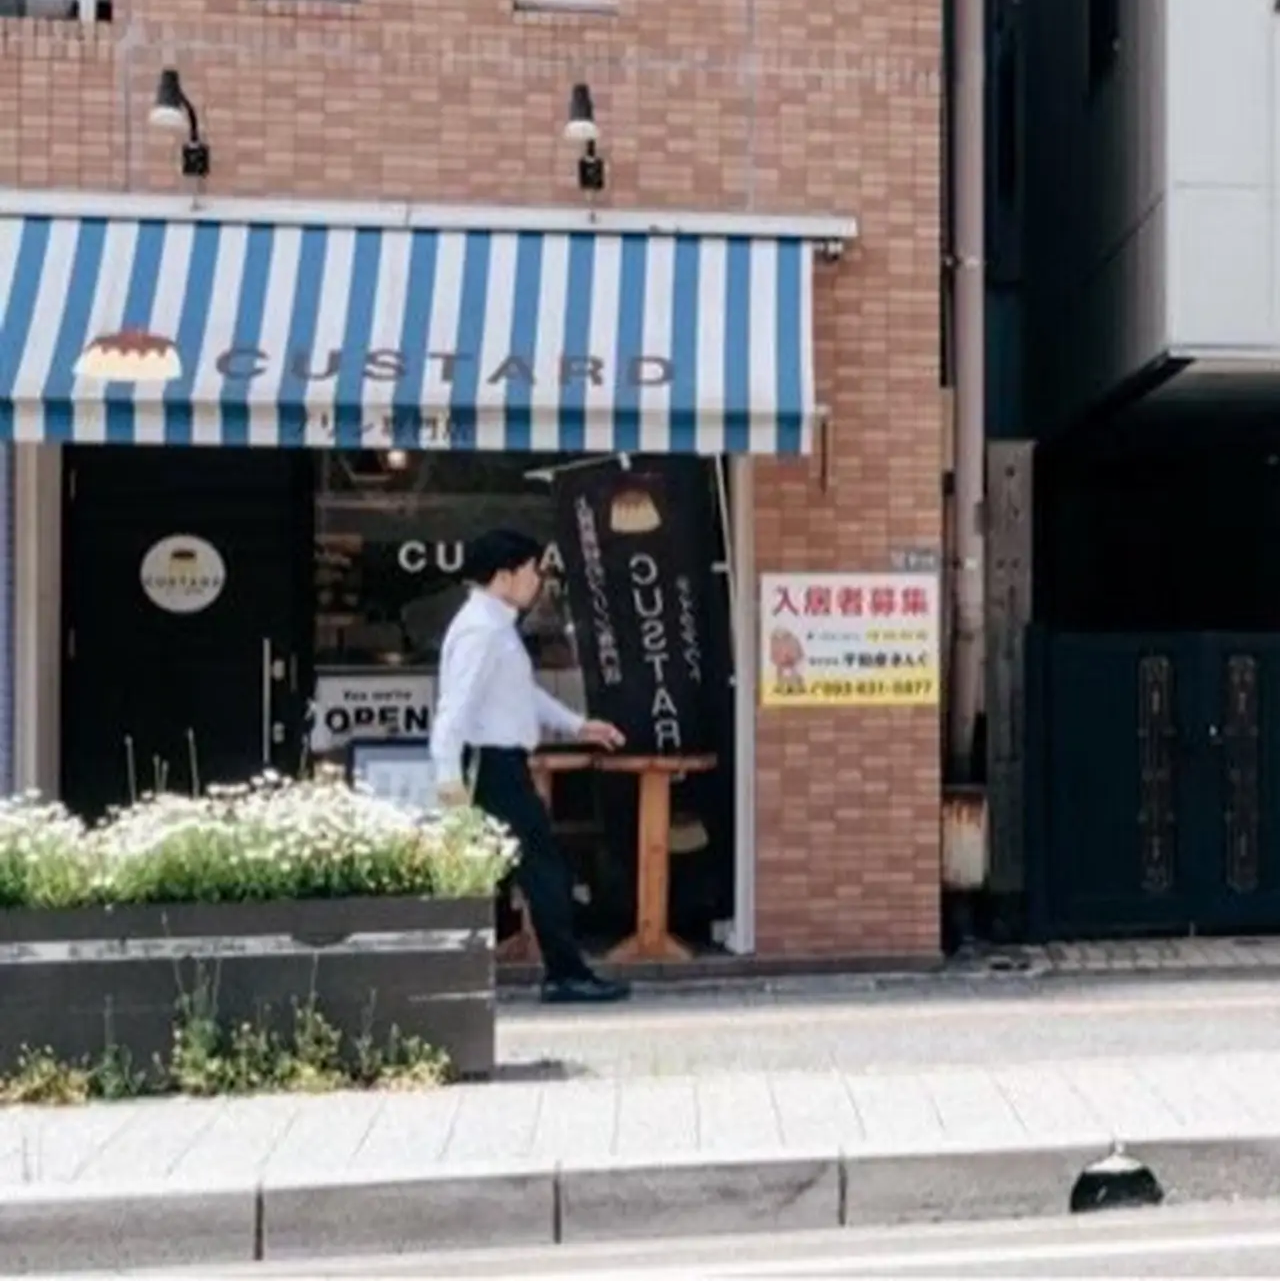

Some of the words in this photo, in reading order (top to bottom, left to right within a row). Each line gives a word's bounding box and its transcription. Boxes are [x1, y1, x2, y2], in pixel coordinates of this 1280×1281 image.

[215, 347, 676, 387] CUSTARD
[772, 585, 929, 617] 入居者募集
[325, 705, 430, 734] OPEN
